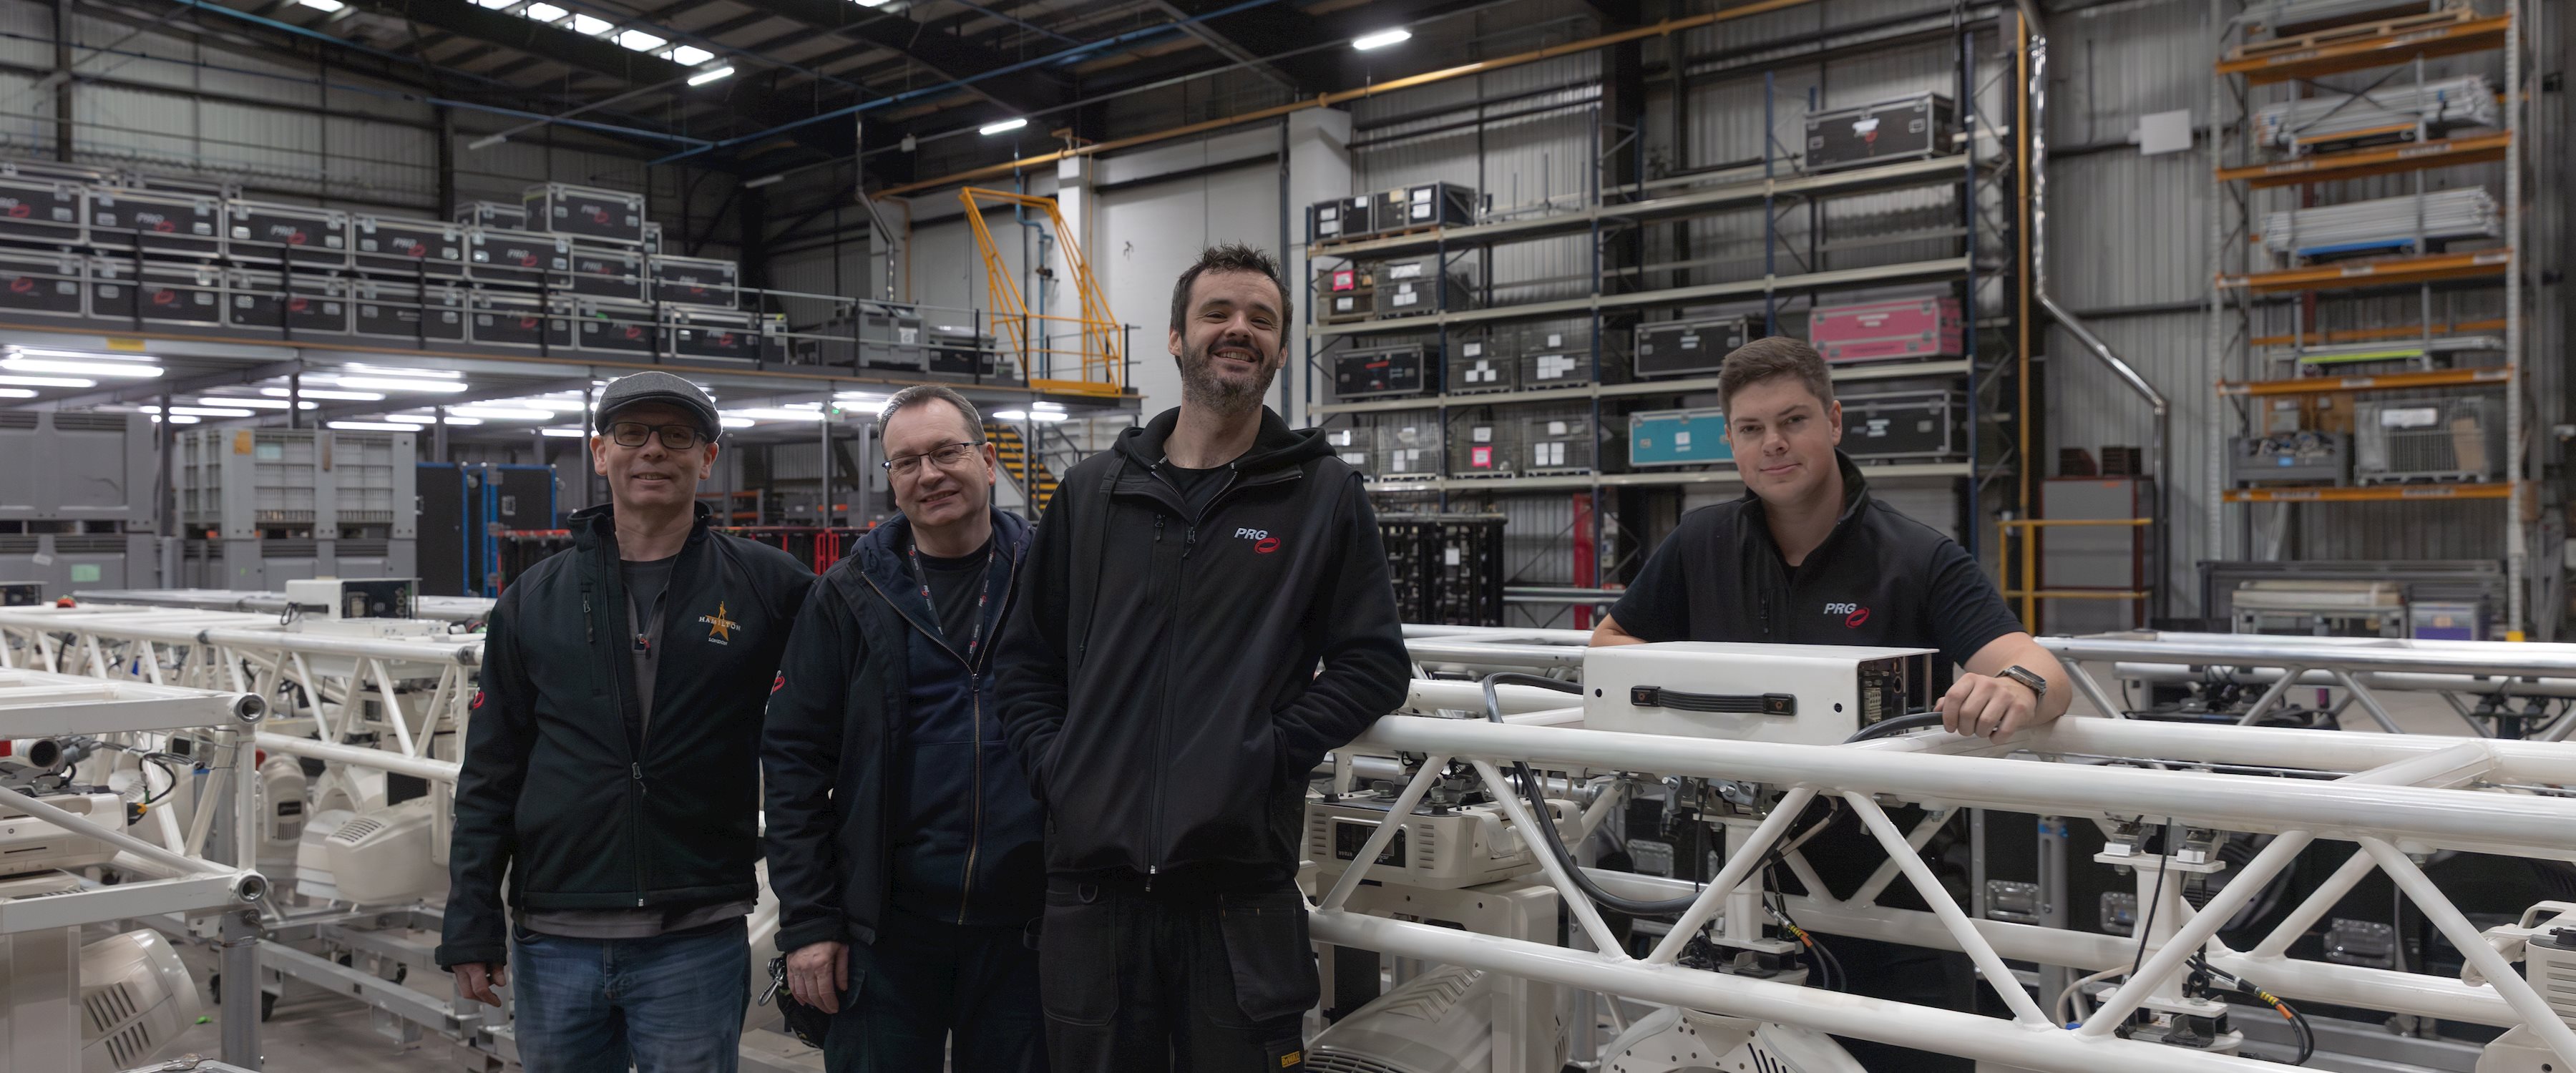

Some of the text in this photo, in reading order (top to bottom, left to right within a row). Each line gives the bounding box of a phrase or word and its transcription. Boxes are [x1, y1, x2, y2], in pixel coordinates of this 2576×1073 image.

[1234, 527, 1268, 540] PRG
[1823, 602, 1858, 614] PRG
[698, 616, 741, 631] HAMILTON
